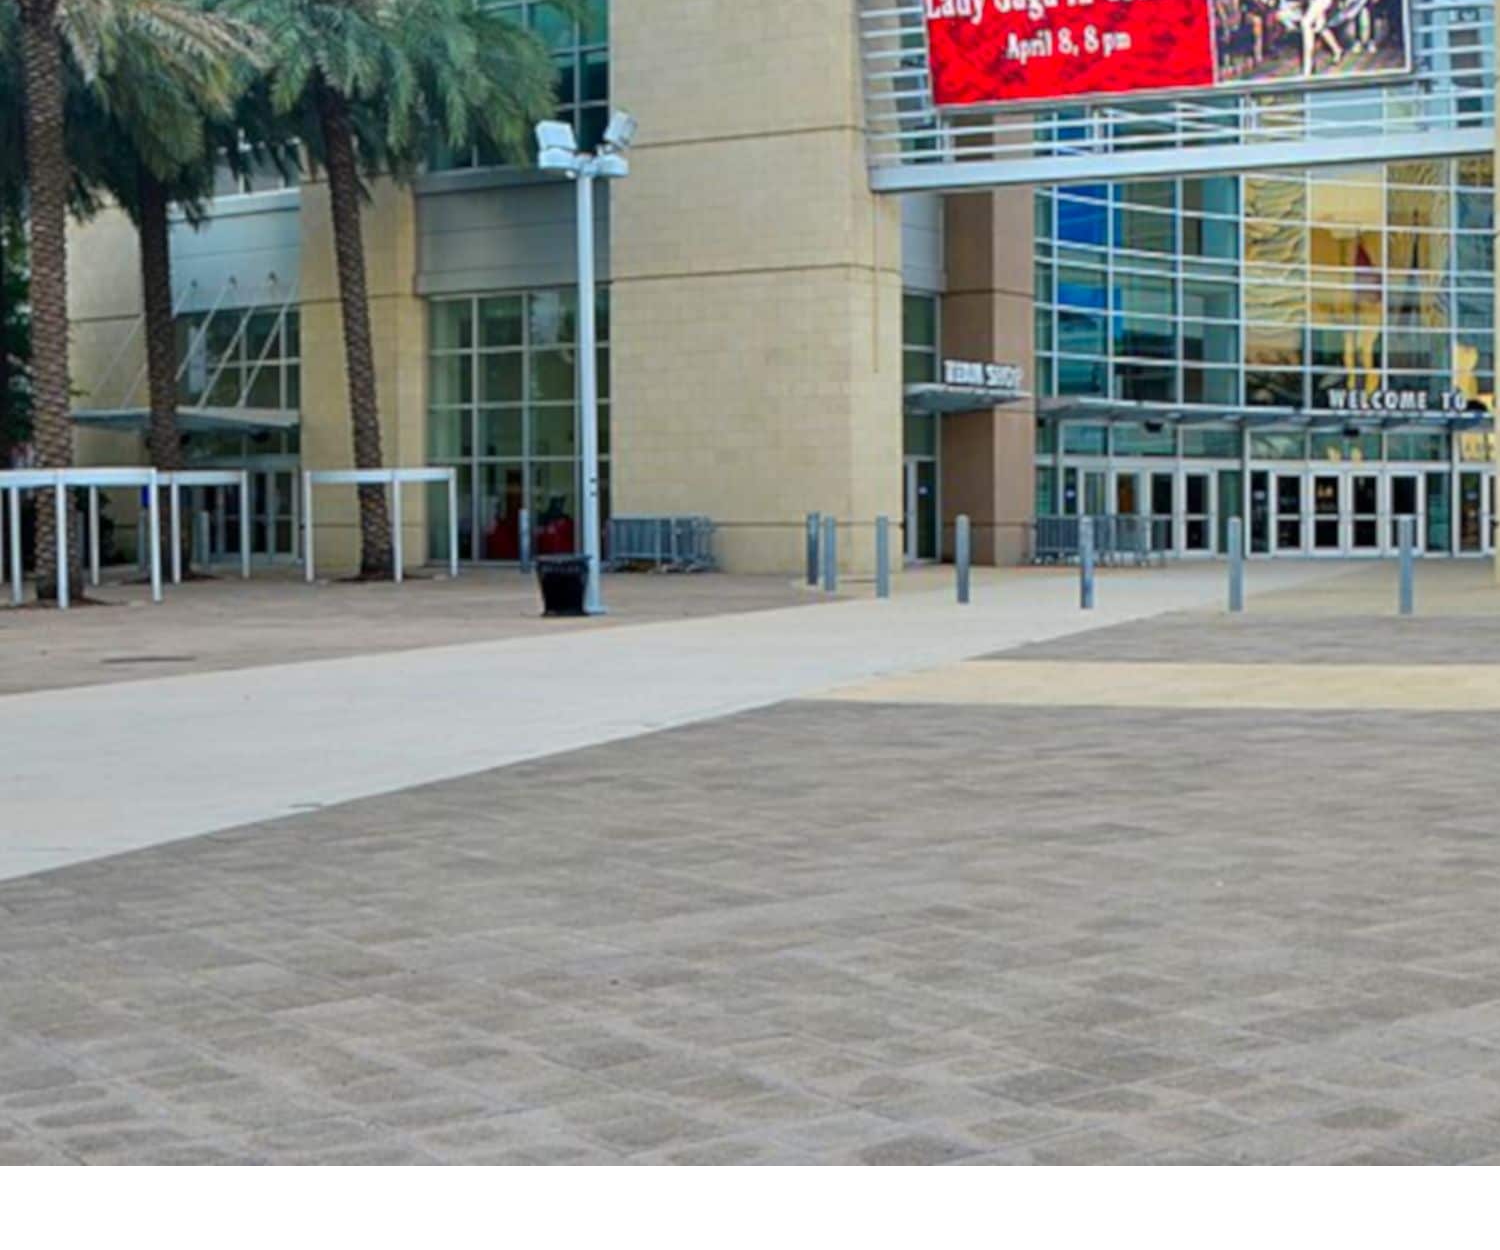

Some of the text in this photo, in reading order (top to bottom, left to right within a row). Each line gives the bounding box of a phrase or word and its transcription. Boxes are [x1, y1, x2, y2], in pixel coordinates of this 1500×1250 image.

[1005, 25, 1132, 64] April 8, 8 pm
[1328, 389, 1467, 411] WELCOME TO
